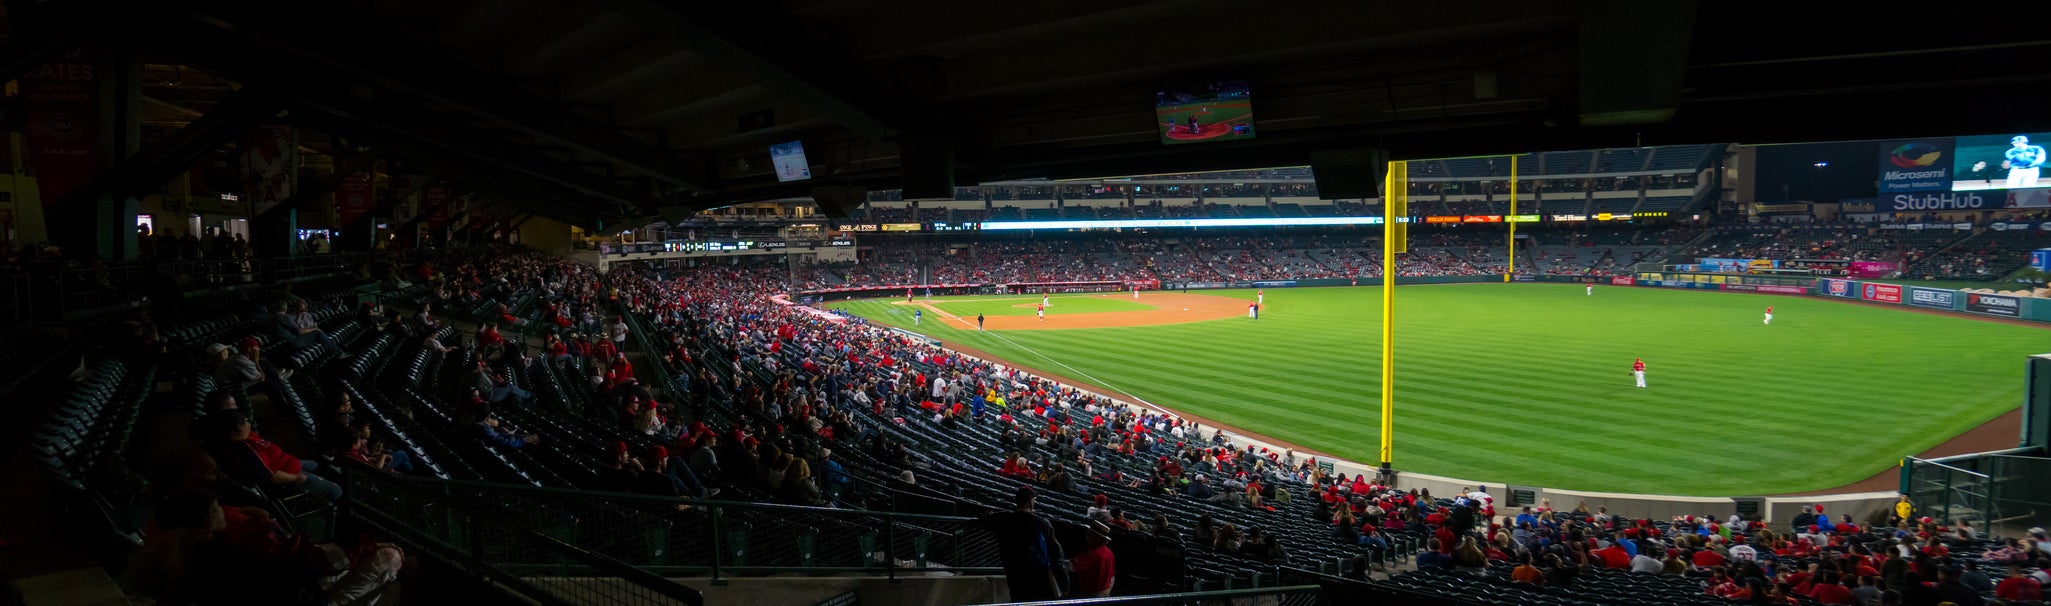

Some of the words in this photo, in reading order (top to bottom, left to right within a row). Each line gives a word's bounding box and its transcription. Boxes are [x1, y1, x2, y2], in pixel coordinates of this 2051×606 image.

[1884, 168, 1946, 181] Microsemi
[1893, 193, 1983, 211] StubHub
[1980, 296, 2017, 307] YOKOHAMA
